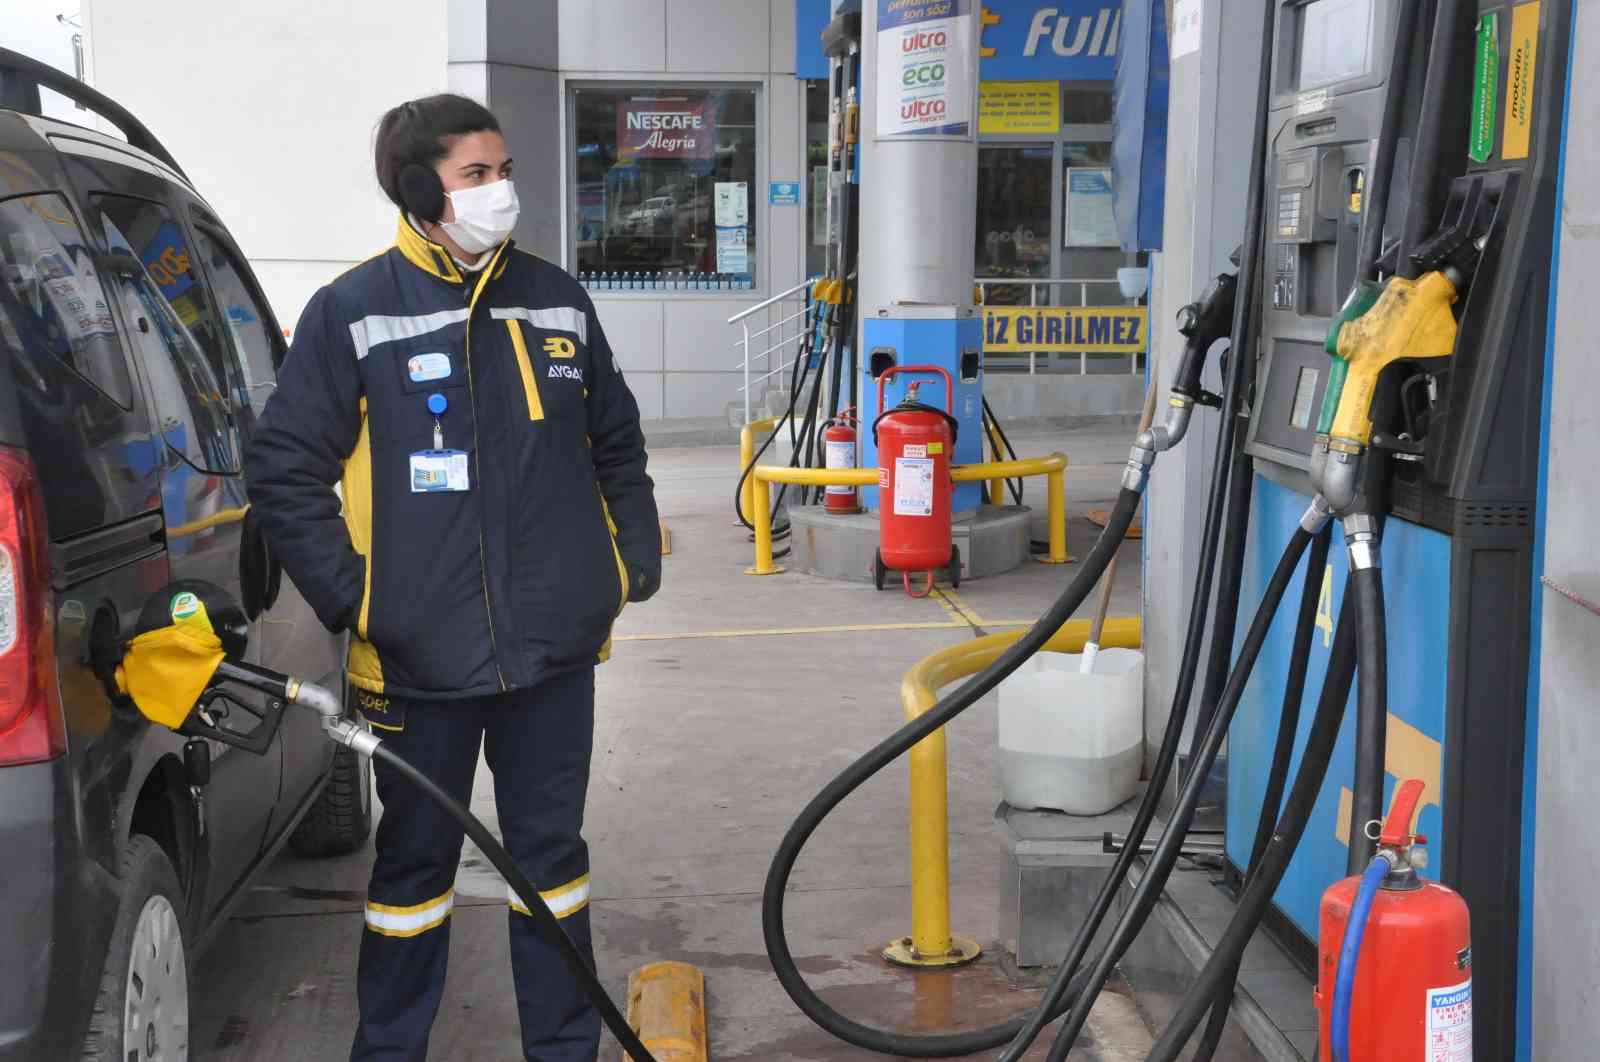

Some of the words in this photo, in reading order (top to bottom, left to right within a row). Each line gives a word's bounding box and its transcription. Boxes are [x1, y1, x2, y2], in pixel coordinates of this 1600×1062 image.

[902, 32, 946, 51] ultra
[902, 63, 945, 85] eco
[1512, 48, 1522, 119] motorin
[900, 99, 945, 119] ultra
[633, 130, 697, 152] Alegria
[1015, 311, 1141, 345] GİRİLMEZ
[1315, 563, 1334, 649] 4
